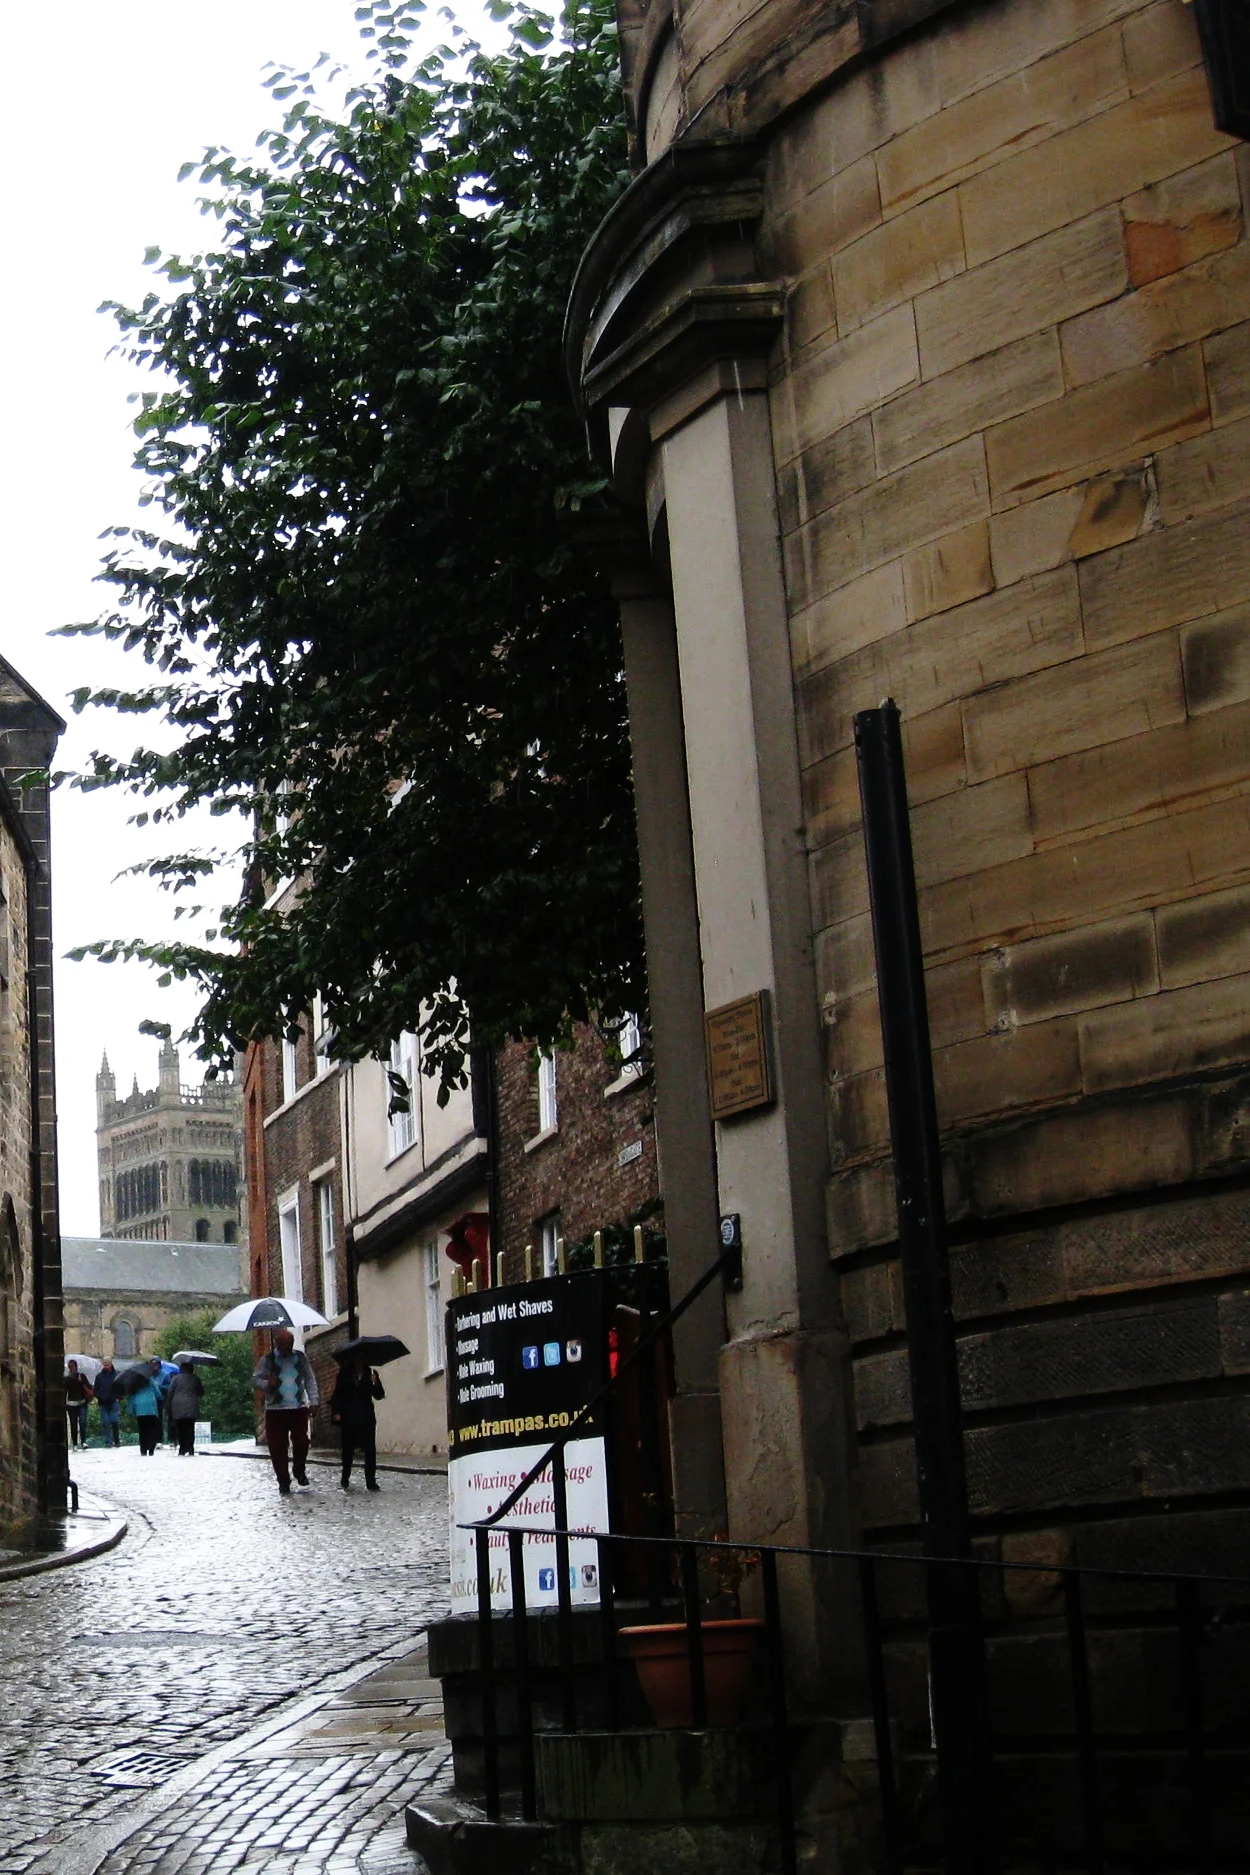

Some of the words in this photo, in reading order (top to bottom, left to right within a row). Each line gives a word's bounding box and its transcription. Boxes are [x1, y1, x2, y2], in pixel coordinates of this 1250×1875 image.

[482, 1307, 496, 1324] and
[498, 1304, 517, 1322] Wet
[519, 1300, 554, 1318] Shaves
[469, 1358, 495, 1376] Waxing
[470, 1381, 505, 1400] Grooming
[473, 1471, 517, 1491] Waxing
